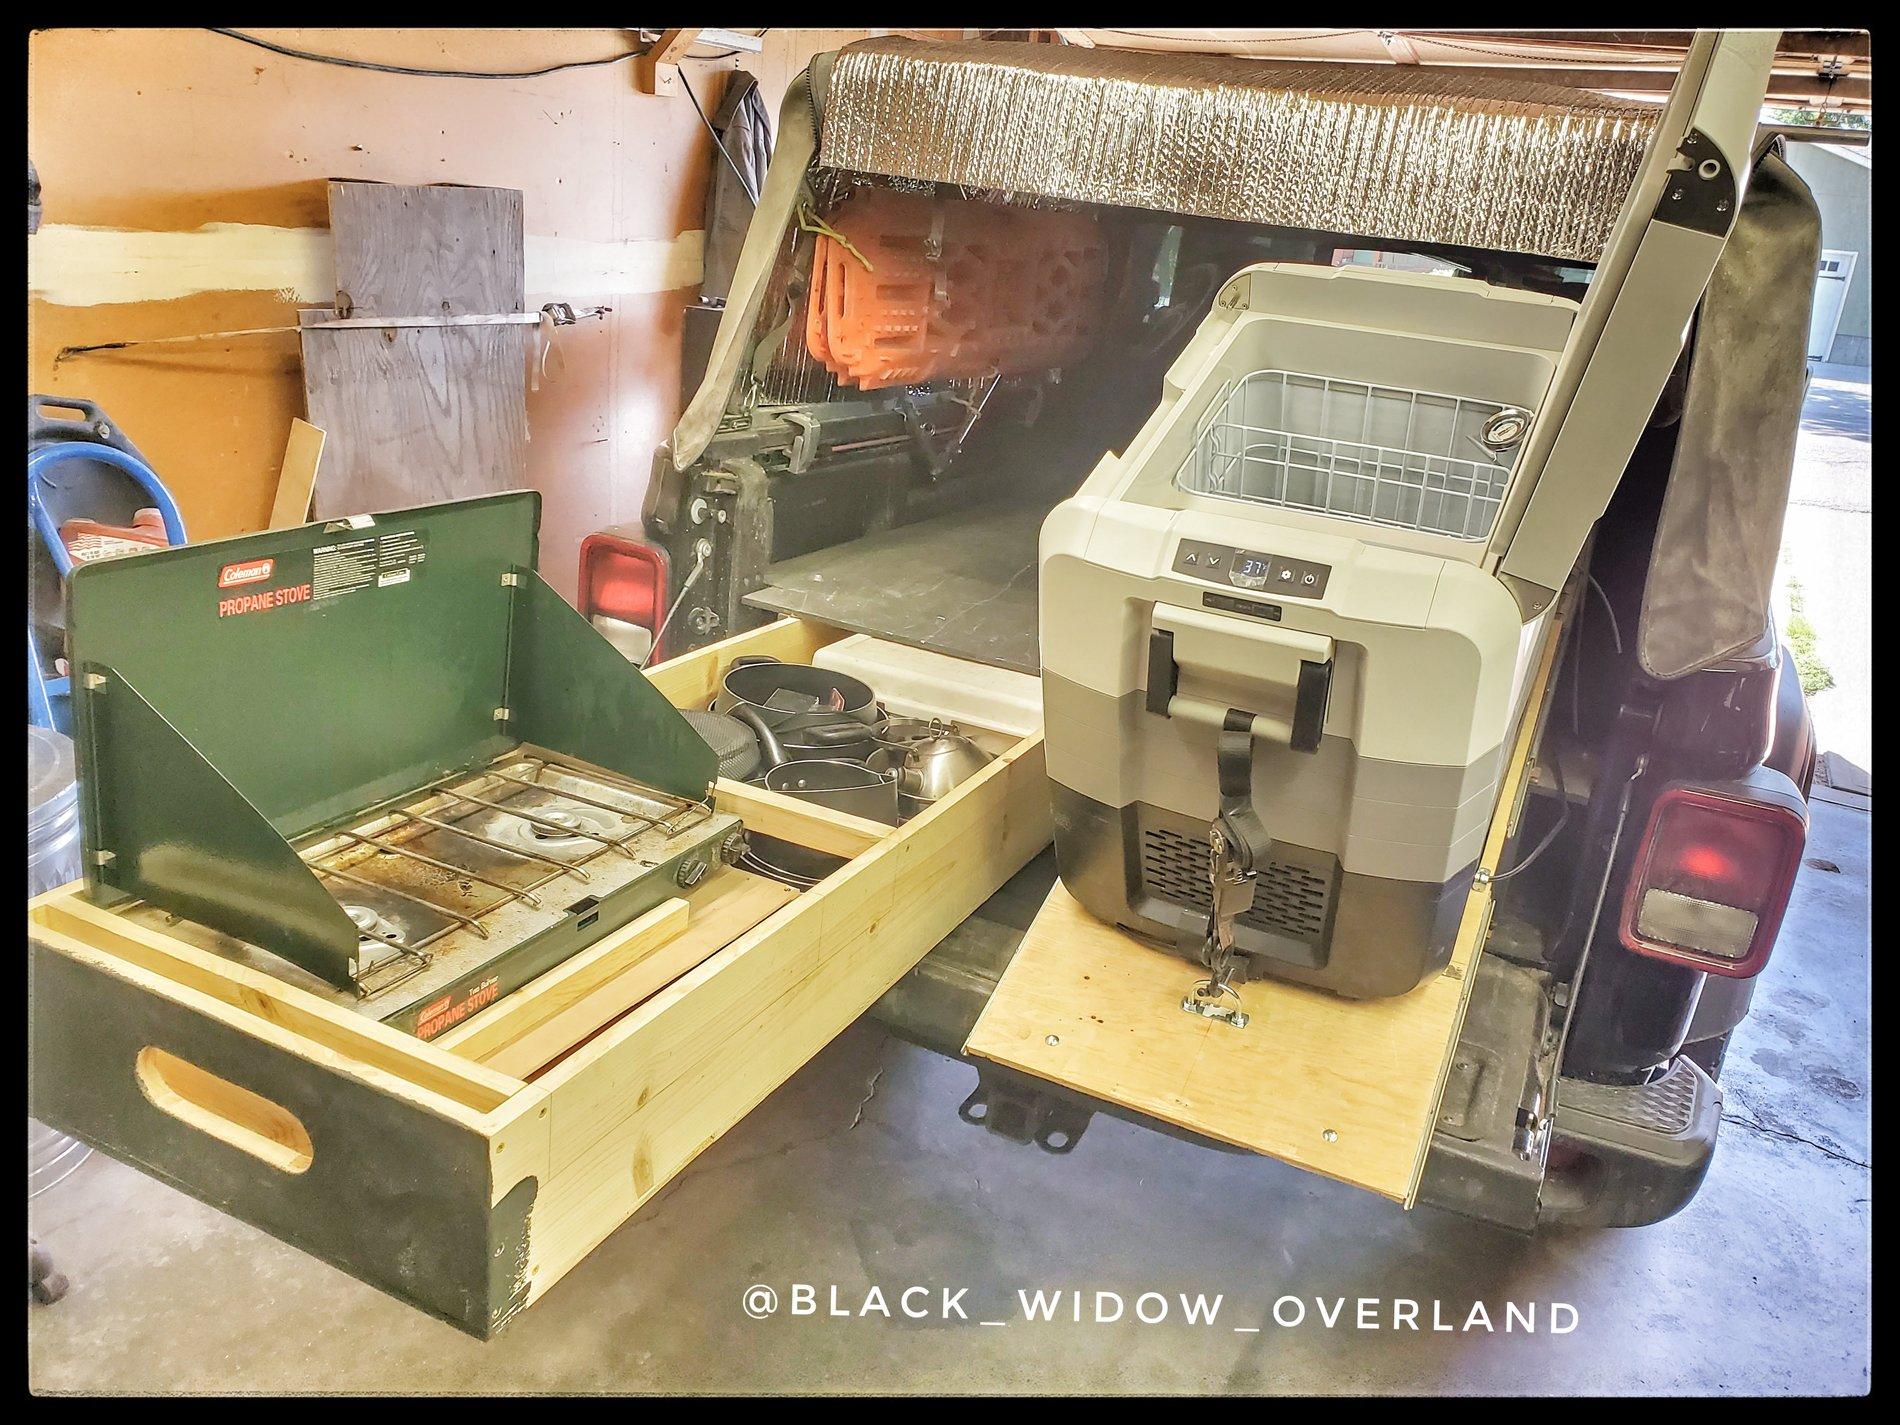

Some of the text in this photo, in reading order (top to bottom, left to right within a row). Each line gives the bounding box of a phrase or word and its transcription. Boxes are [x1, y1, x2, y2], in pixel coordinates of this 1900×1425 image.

[224, 566, 263, 582] Coleman
[219, 584, 311, 617] PROPANE STOVE
[417, 983, 498, 1038] PROPANE STOVE
